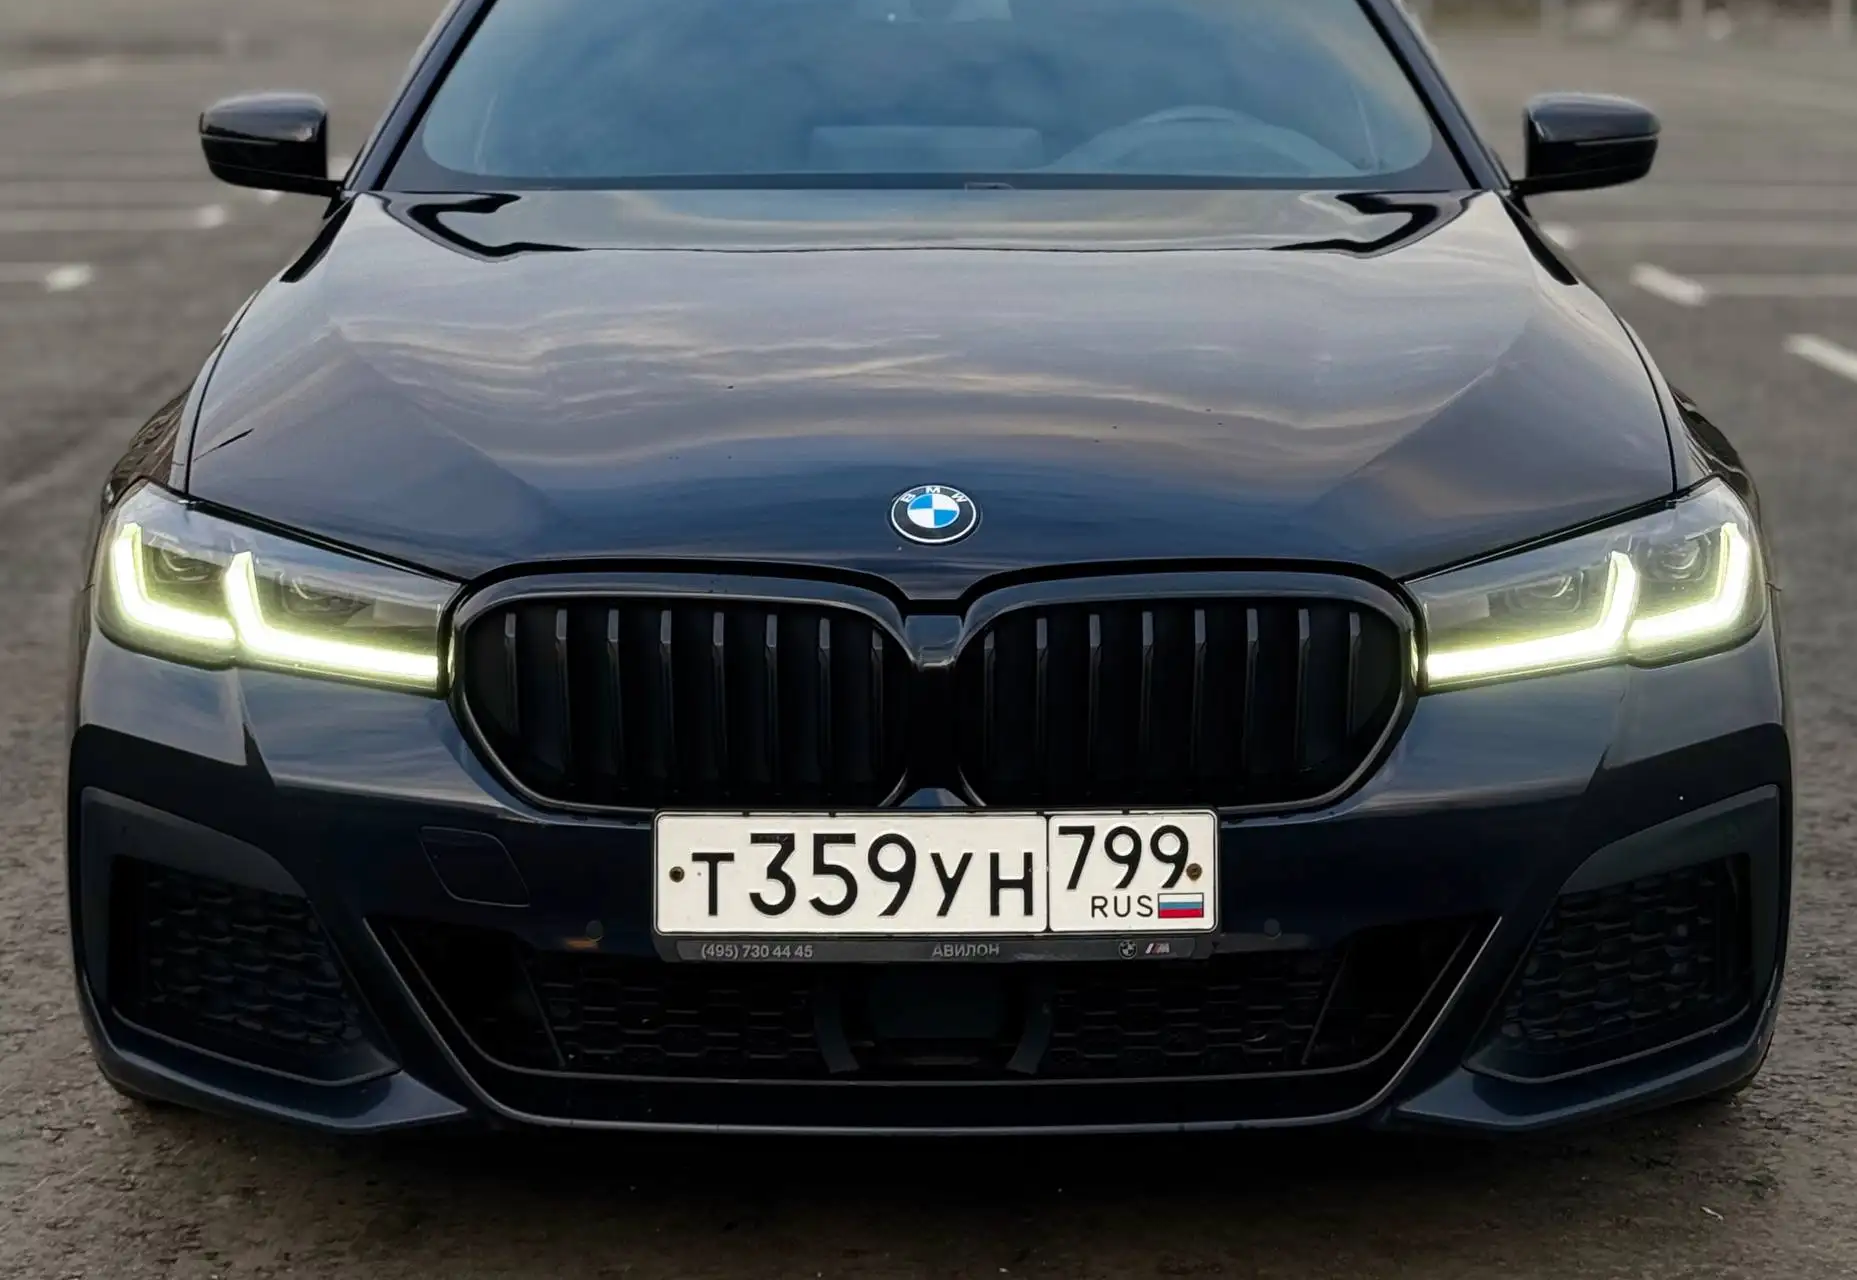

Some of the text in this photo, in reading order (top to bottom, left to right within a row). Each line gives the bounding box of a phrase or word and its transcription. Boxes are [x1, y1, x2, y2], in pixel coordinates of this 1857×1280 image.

[900, 486, 968, 503] BMW
[1058, 824, 1189, 890] 799
[1091, 895, 1153, 918] RUS
[701, 943, 813, 959] (495) 730 44 45
[931, 943, 1000, 957] АВИЛОН
